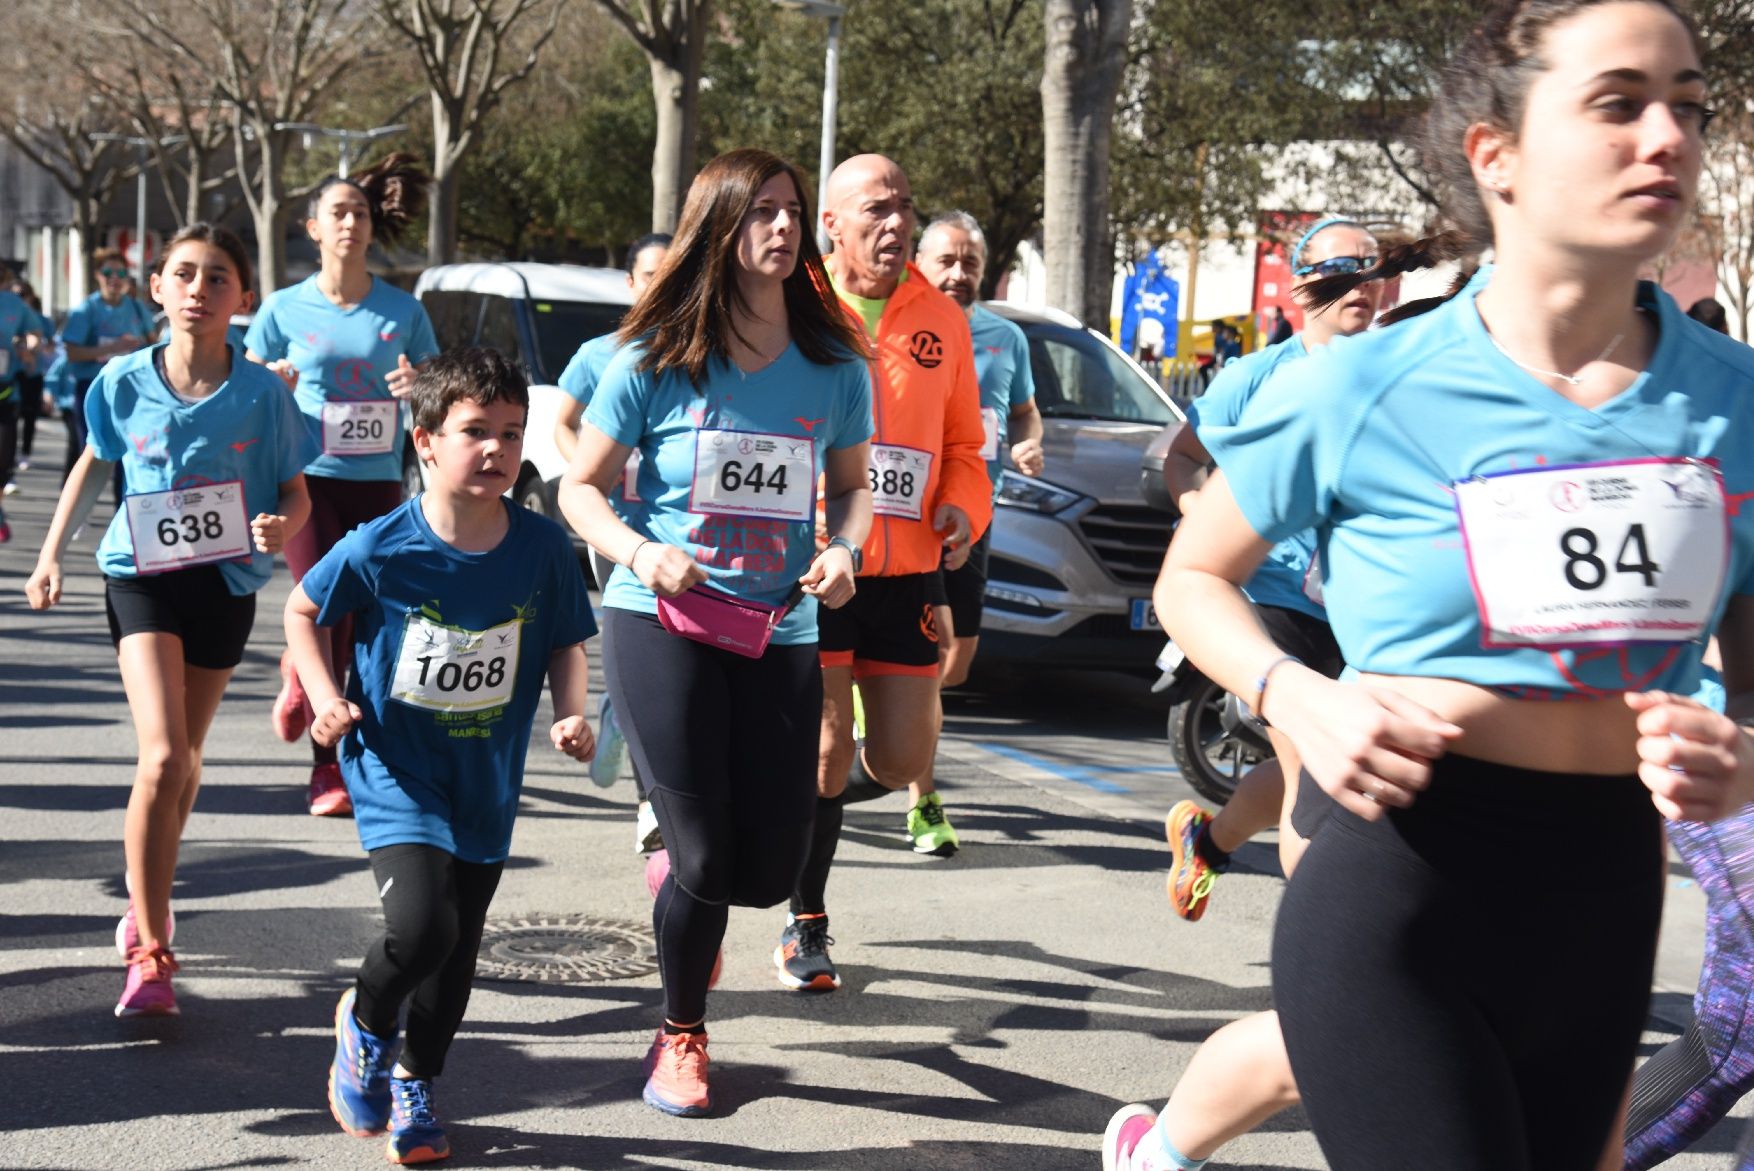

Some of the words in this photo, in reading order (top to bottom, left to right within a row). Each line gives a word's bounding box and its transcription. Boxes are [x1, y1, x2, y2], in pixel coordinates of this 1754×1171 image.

[341, 419, 384, 439] 250
[721, 460, 788, 495] 644
[157, 511, 223, 547] 638
[720, 530, 743, 550] LA
[1560, 523, 1662, 591] 84
[416, 656, 506, 692] 1068
